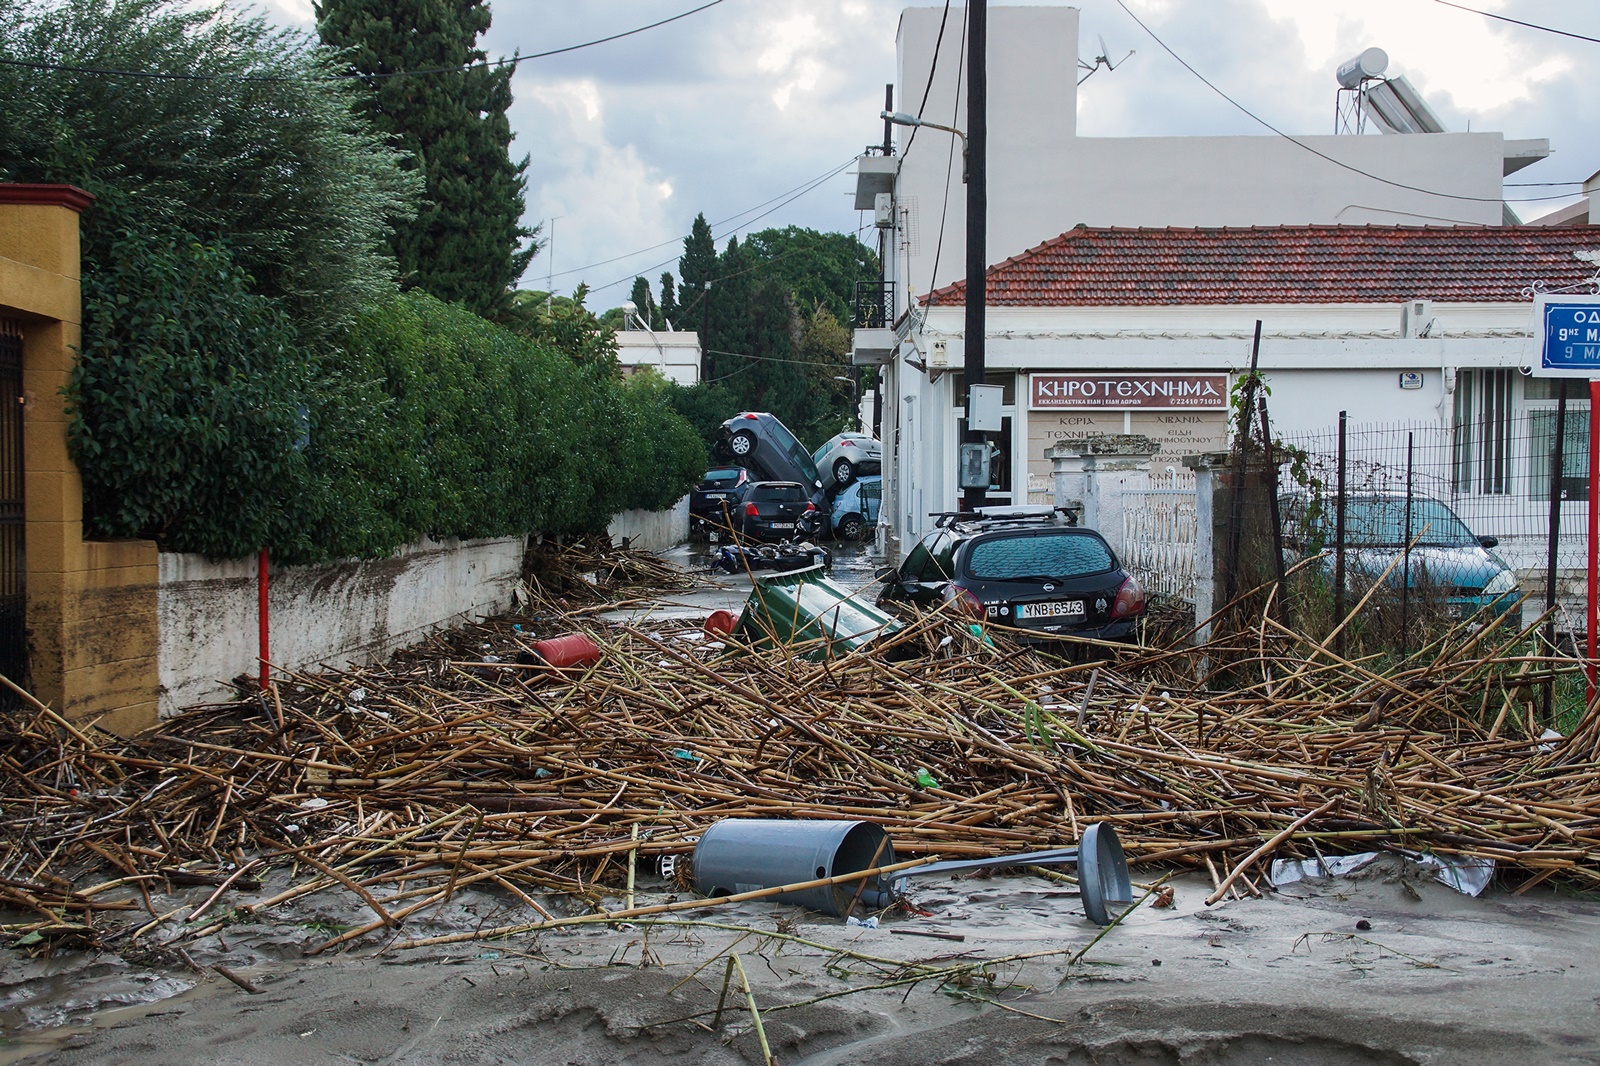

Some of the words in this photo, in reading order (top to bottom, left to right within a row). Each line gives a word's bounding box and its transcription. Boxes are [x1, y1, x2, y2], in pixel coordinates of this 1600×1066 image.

[1574, 311, 1600, 323] ΟΔ
[1587, 328, 1600, 341] Μ
[1565, 346, 1573, 359] 9
[1038, 380, 1220, 397] ΚΗΡΟΤΕΧΝΗΜΑ
[1059, 417, 1096, 425] ΚΕΡΙΑ
[1156, 416, 1204, 424] ΛΙΒΑΝΙΑ
[1054, 601, 1082, 614] 6543
